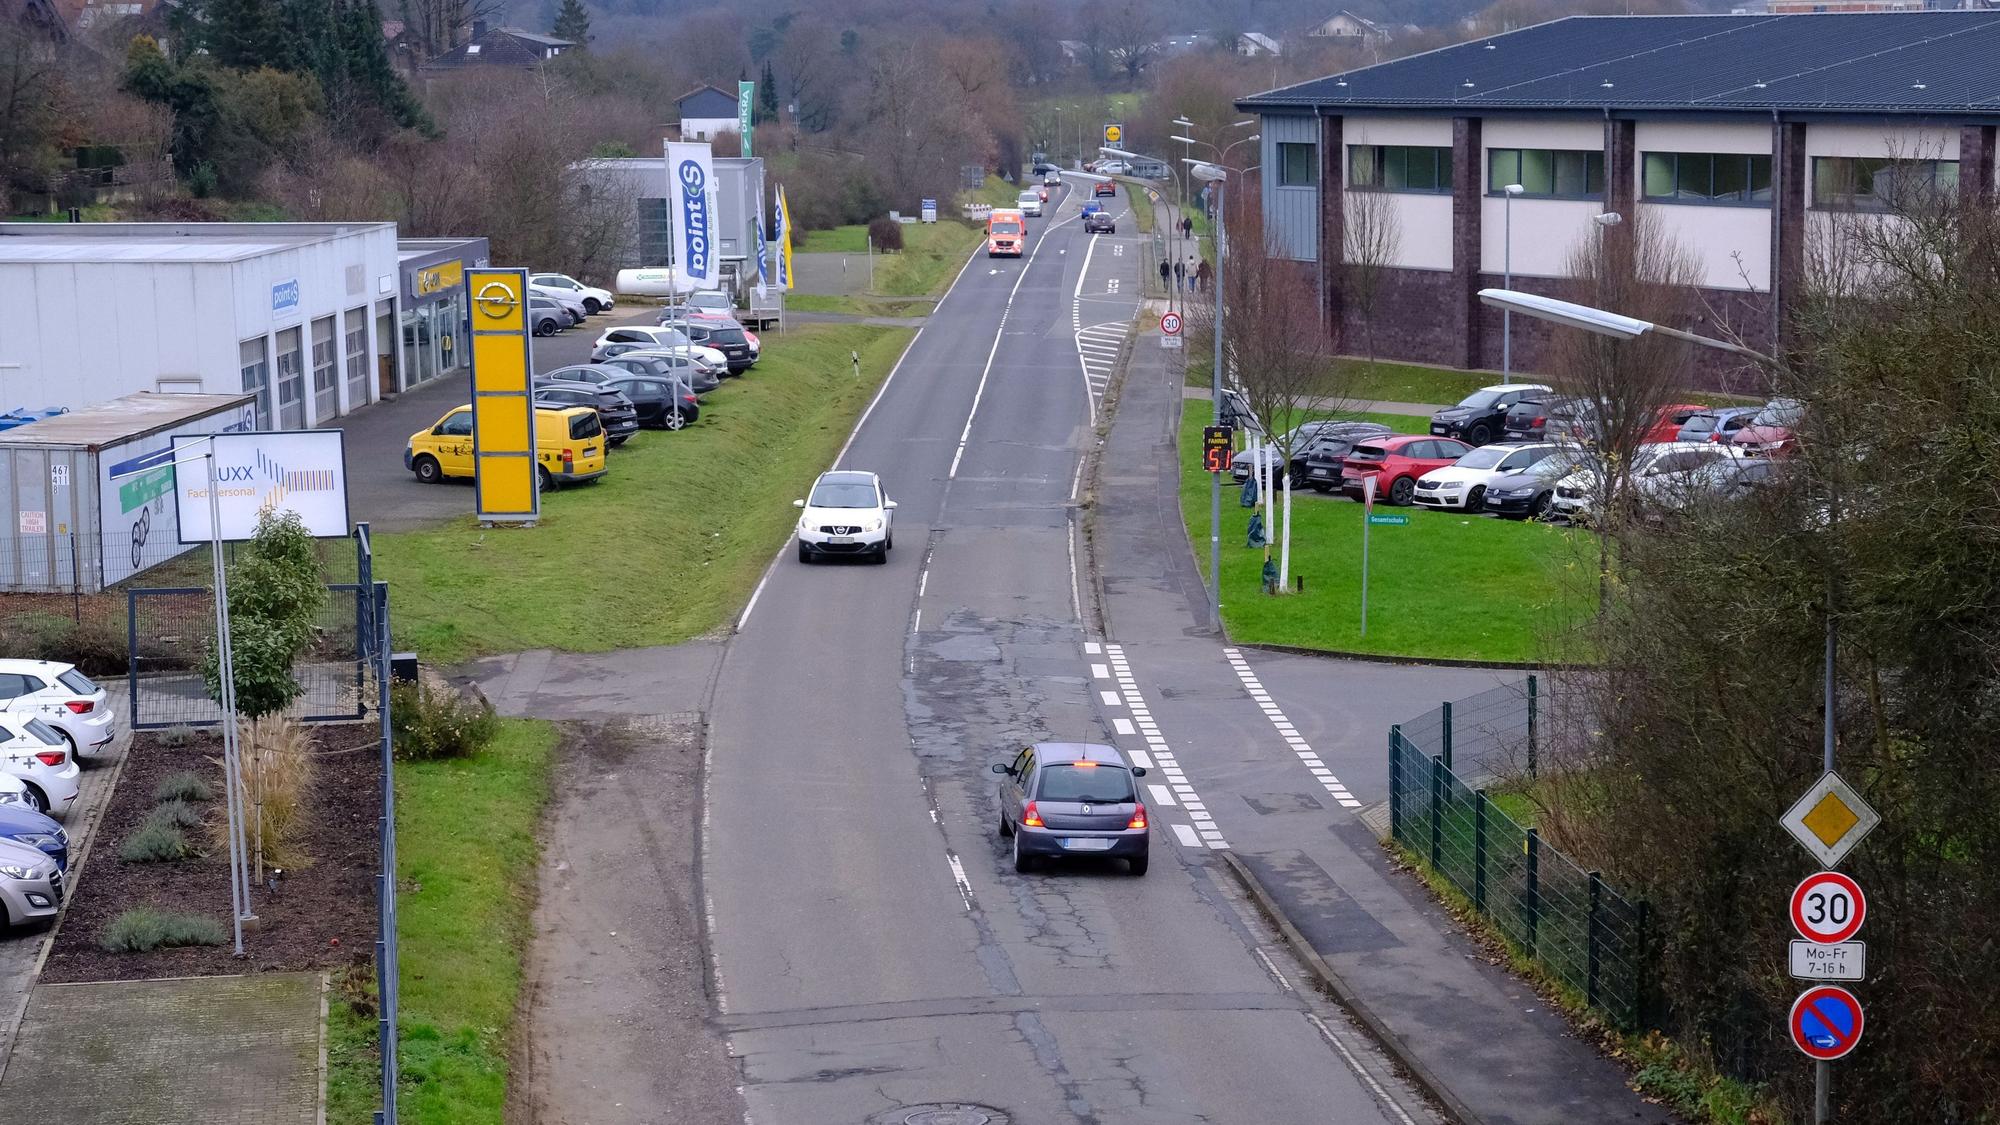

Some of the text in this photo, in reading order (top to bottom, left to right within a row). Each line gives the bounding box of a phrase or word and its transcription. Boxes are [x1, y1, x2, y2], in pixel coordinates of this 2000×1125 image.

[741, 89, 750, 133] DEKRA
[683, 164, 705, 271] point S
[274, 282, 299, 308] point S
[1165, 318, 1178, 329] 30
[1209, 448, 1231, 472] 51
[52, 465, 68, 476] 467
[52, 476, 68, 485] 411
[53, 486, 58, 495] 8
[187, 487, 256, 498] Fachersonal
[1371, 516, 1404, 524] Gesamtschule
[1807, 893, 1849, 924] 30
[1806, 947, 1848, 959] Mo-Fr
[1808, 962, 1846, 974] 7-16 h
